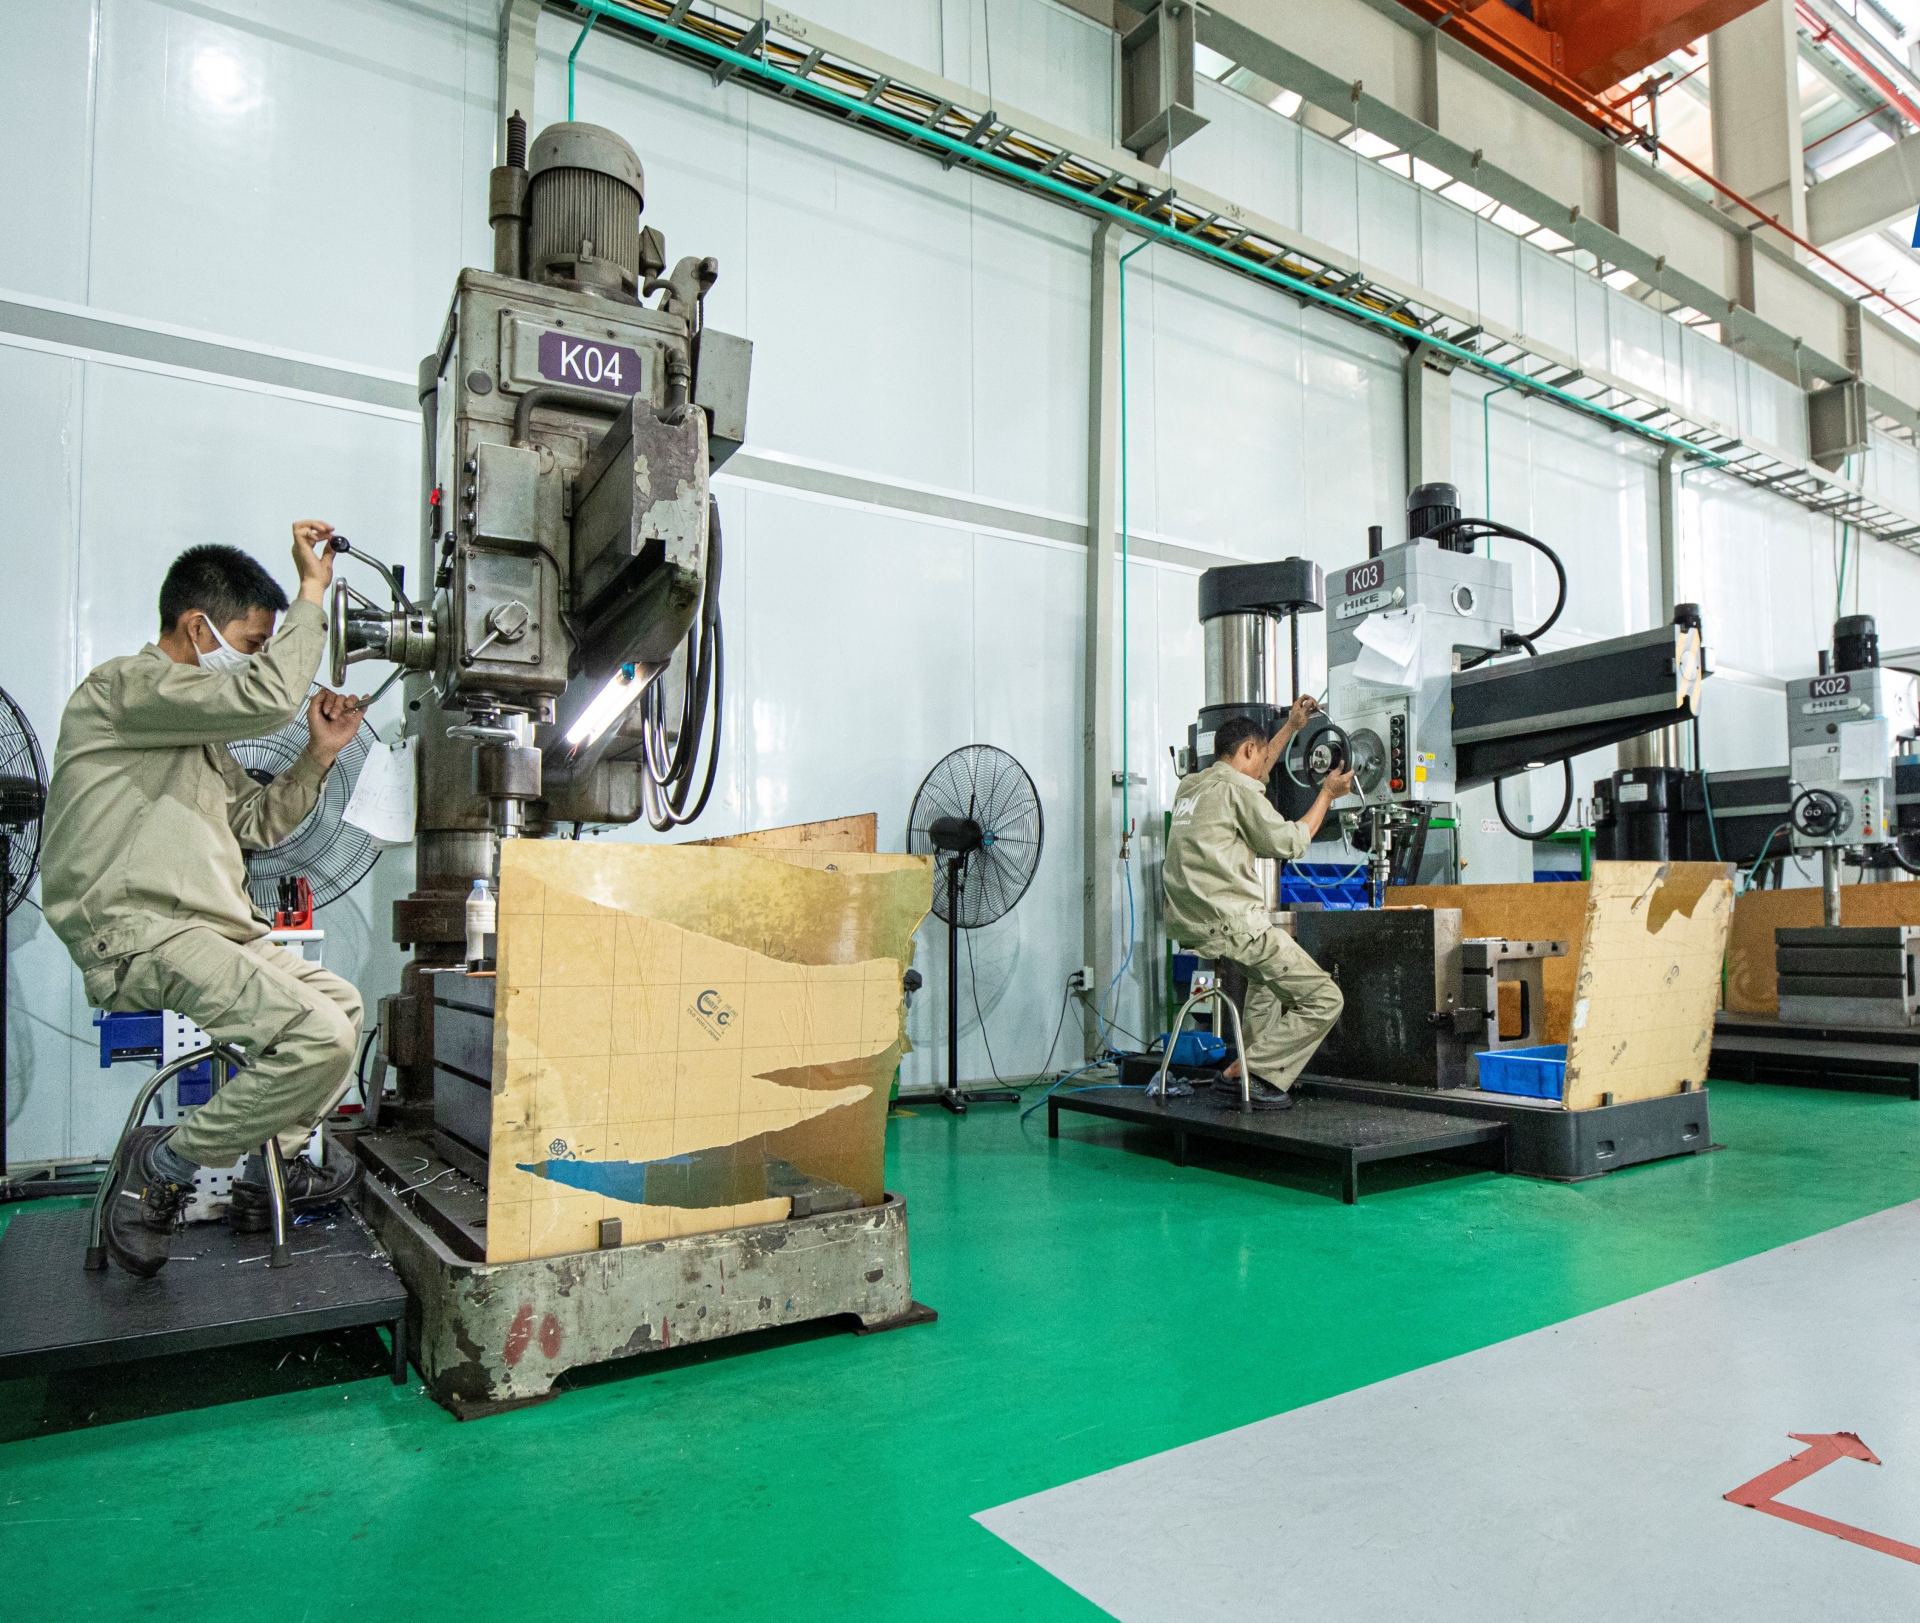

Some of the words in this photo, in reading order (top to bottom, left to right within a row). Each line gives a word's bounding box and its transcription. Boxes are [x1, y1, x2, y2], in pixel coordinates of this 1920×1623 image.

[561, 341, 623, 387] K04
[1352, 565, 1378, 592] K03
[1344, 593, 1379, 611] HIKE
[1814, 678, 1846, 697] K02
[1812, 700, 1849, 709] HIKE
